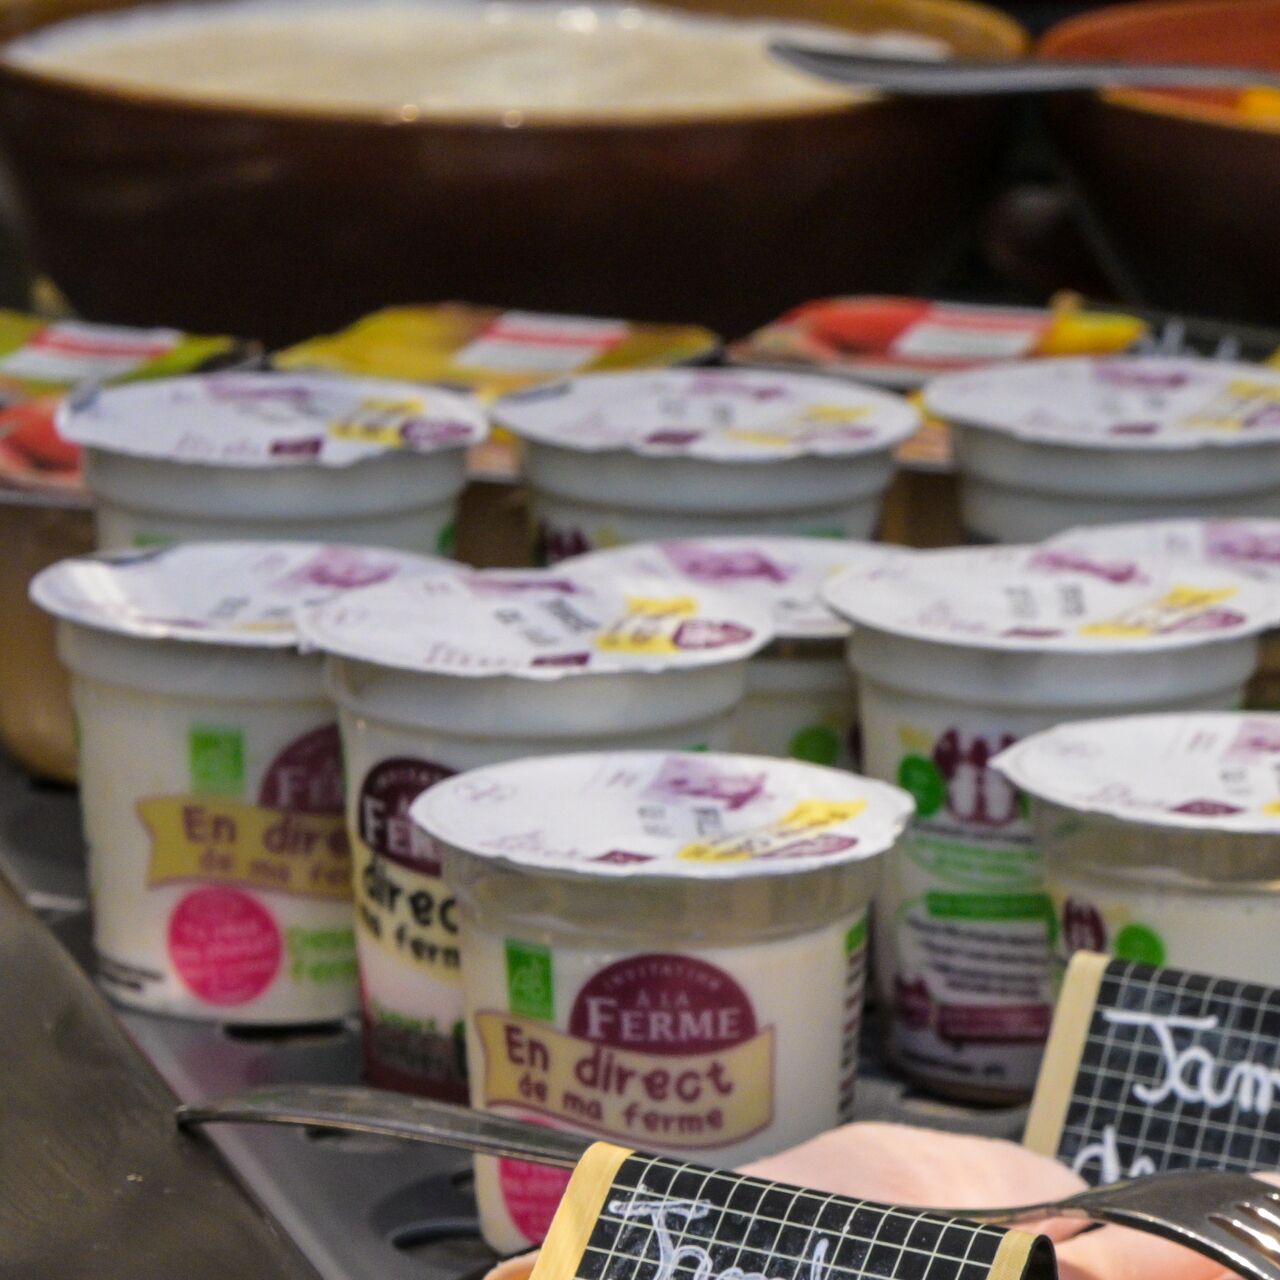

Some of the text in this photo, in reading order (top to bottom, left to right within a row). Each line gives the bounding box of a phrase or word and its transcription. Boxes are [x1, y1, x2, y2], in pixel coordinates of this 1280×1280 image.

[181, 804, 238, 845] En
[585, 994, 742, 1043] FERME
[503, 1023, 551, 1072] En
[574, 1042, 735, 1103] direct
[518, 1073, 725, 1135] de ma ferme
